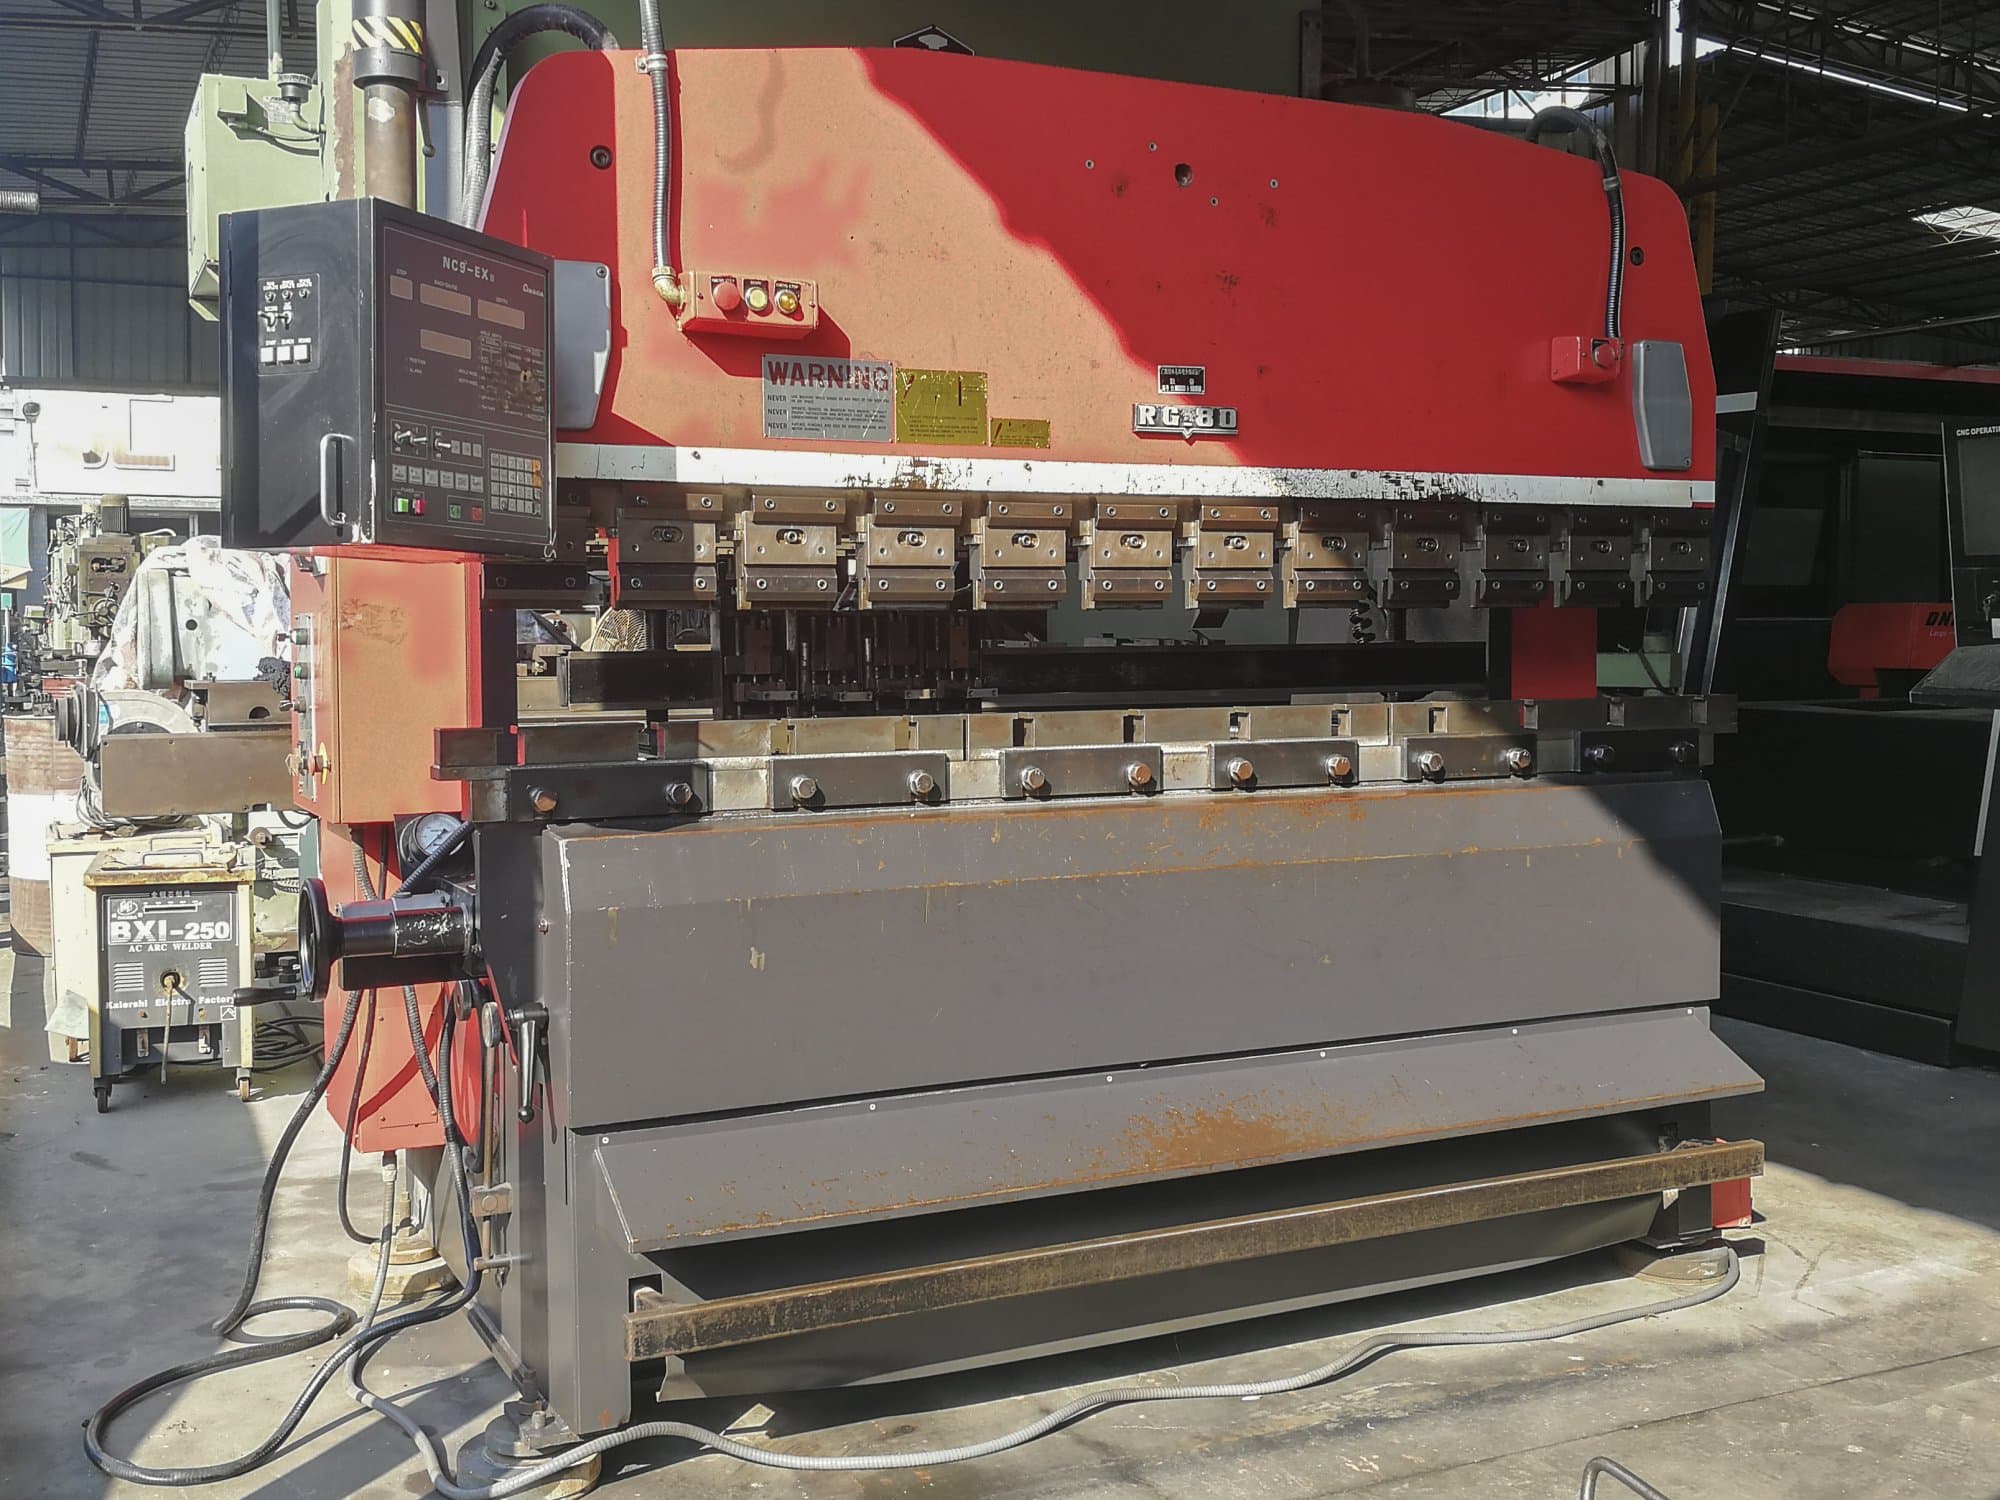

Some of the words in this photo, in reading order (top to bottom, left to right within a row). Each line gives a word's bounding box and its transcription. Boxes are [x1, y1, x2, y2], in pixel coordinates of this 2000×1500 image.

[442, 255, 489, 281] NC9-EX
[767, 361, 889, 392] WARNING
[767, 394, 787, 402] NEVER
[767, 408, 787, 416] NEVER
[767, 422, 788, 430] NEVER
[1956, 428, 1970, 437] CNC
[128, 945, 143, 953] AC
[147, 943, 168, 952] ARC
[172, 942, 213, 951] WELDER
[198, 995, 235, 1005] Factory
